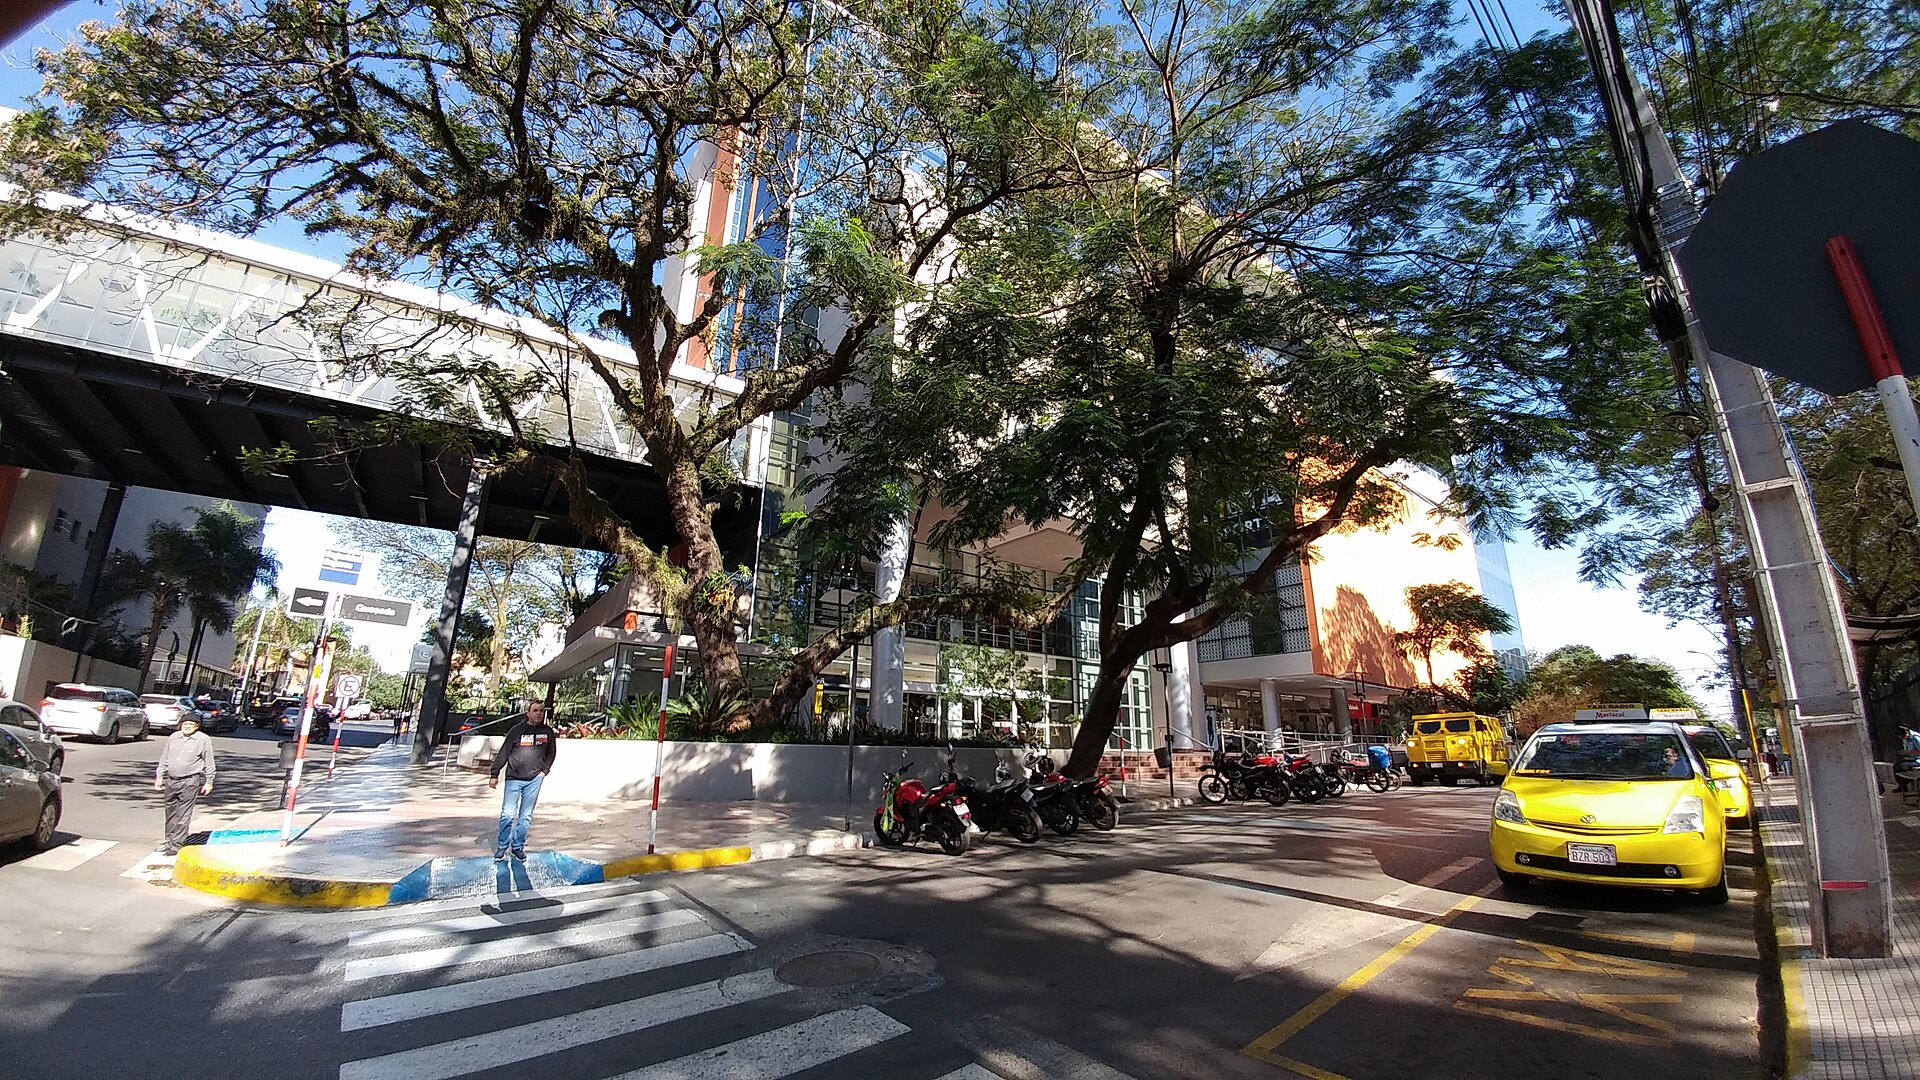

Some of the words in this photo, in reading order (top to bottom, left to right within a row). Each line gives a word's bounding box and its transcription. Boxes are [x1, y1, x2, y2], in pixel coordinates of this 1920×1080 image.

[1595, 711, 1625, 719] Mariscal
[1572, 851, 1591, 862] BZR
[1592, 853, 1610, 863] 503
